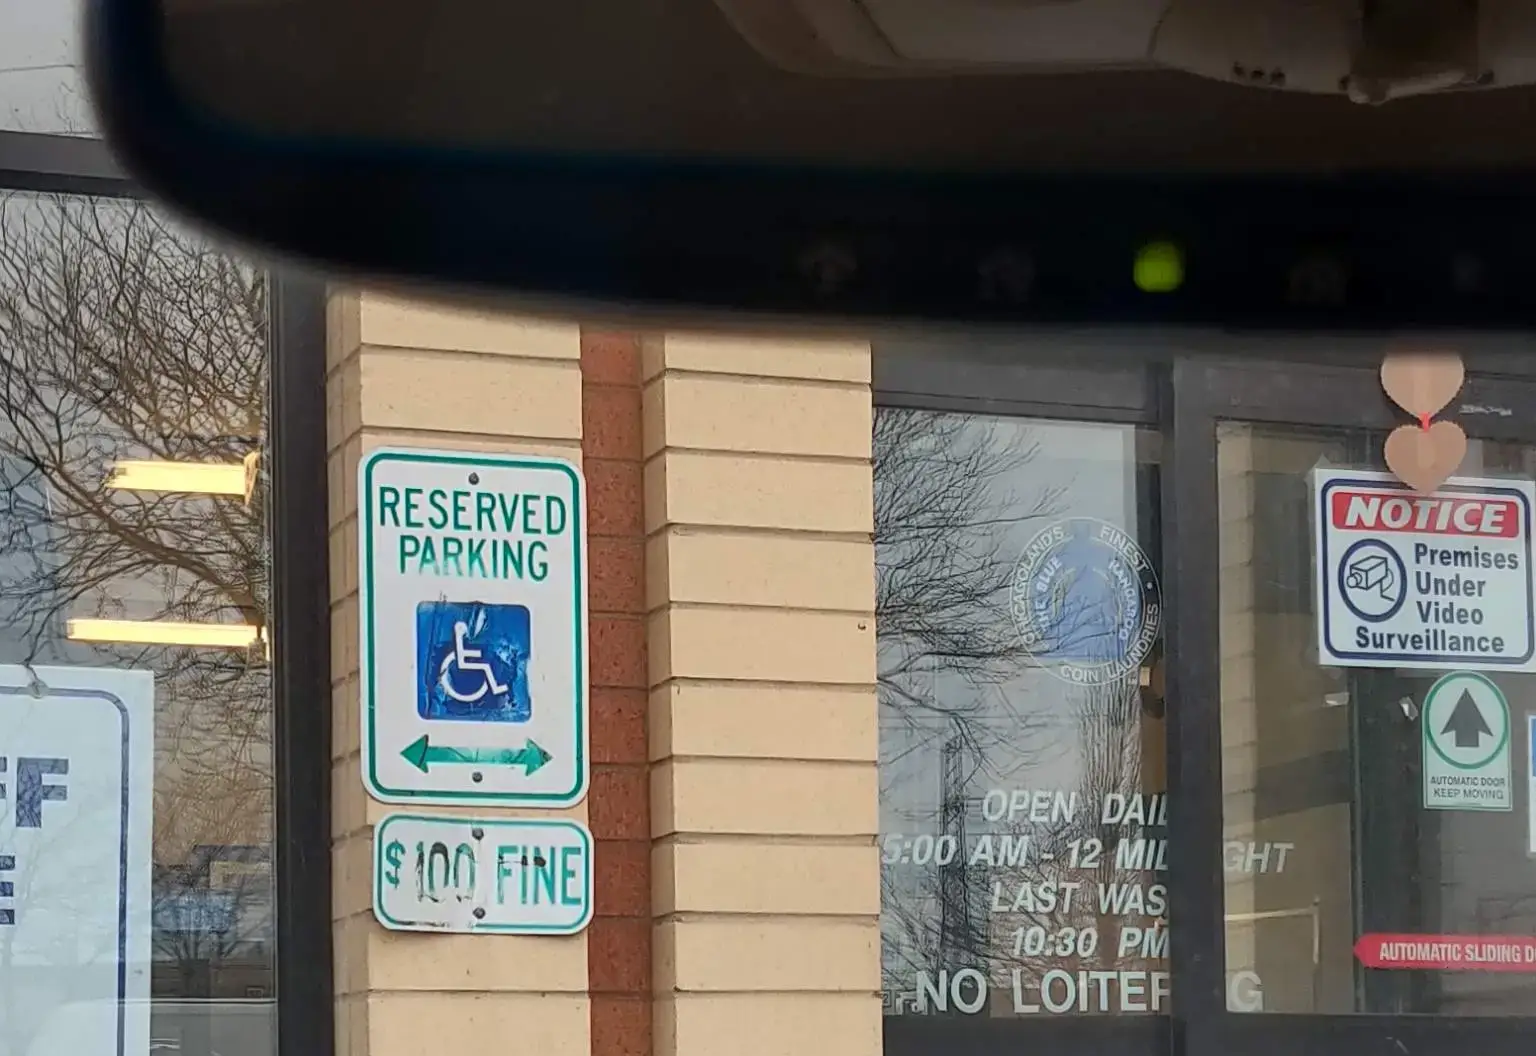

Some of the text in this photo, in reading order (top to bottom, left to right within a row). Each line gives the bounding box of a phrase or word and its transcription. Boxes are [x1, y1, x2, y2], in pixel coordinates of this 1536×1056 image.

[379, 486, 566, 536] RESERVED
[1345, 496, 1507, 533] NOTICE
[399, 535, 549, 582] PARKING
[1100, 526, 1150, 573] FINEST
[1414, 543, 1519, 570] Premises
[1036, 556, 1063, 592] BLUE
[1415, 571, 1486, 597] Under
[1416, 601, 1484, 625] Video
[1060, 603, 1159, 683] COIN LAUNDRIES
[1356, 626, 1505, 653] Surveillance
[1430, 776, 1506, 787] AUTOMATIC DOOR
[1433, 788, 1504, 800] KEEP MOVING
[982, 790, 1168, 826] OPEN DAIL
[968, 834, 1030, 867] AM
[1066, 838, 1102, 869] 12
[496, 845, 582, 906] FINE
[991, 882, 1168, 916] LAST WAS
[1012, 926, 1170, 959] 10:30 PM
[1380, 942, 1462, 961] AUTOMATIC
[1464, 943, 1521, 963] SLIDING
[916, 969, 988, 1013] NO
